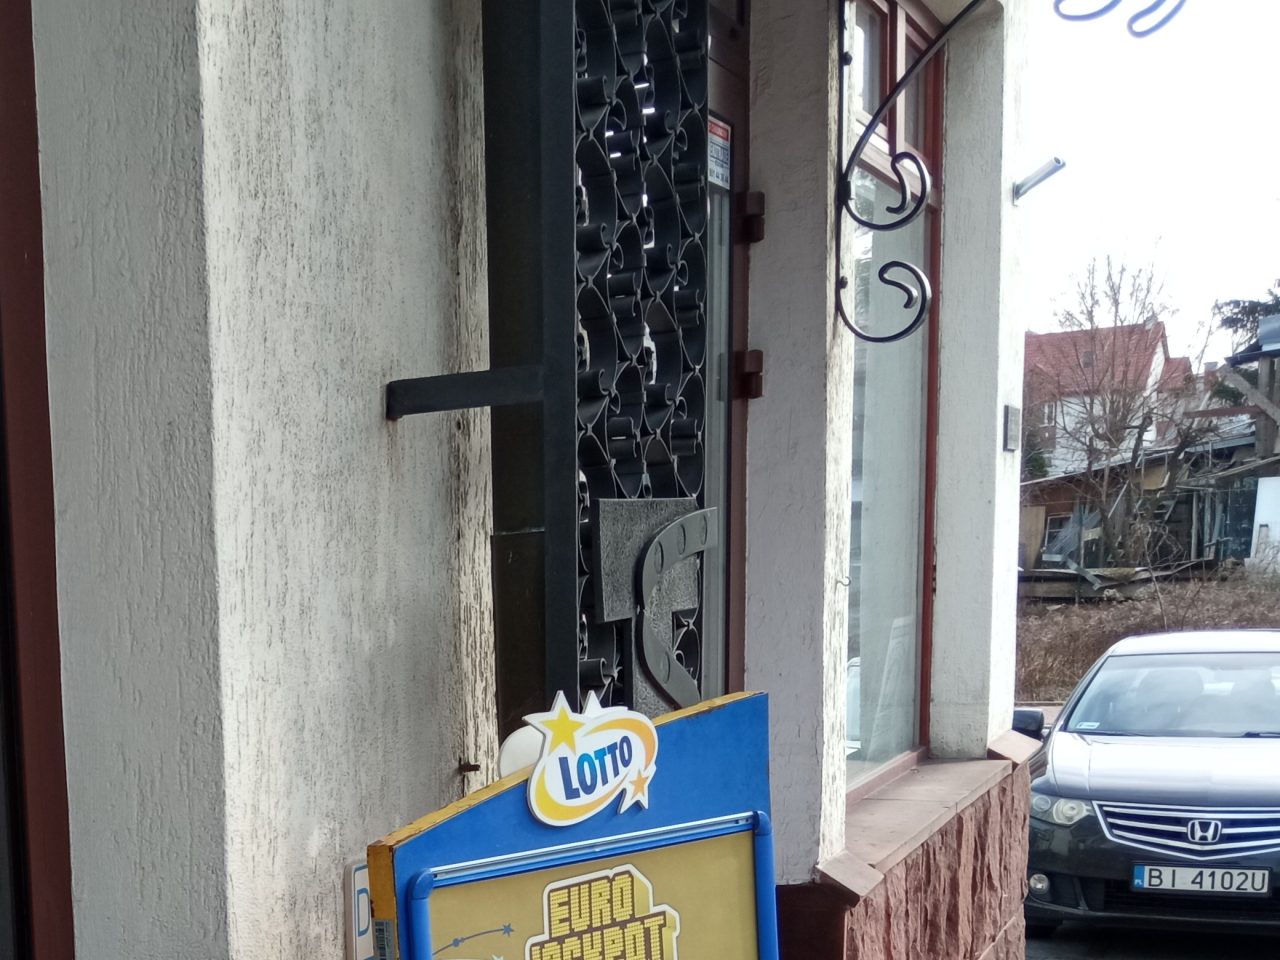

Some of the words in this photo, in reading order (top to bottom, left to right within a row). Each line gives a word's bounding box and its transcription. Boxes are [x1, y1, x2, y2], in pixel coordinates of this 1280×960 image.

[558, 735, 633, 801] LOTTO
[549, 871, 635, 937] EURO
[1148, 868, 1176, 888] BI
[1191, 870, 1266, 892] 4102U
